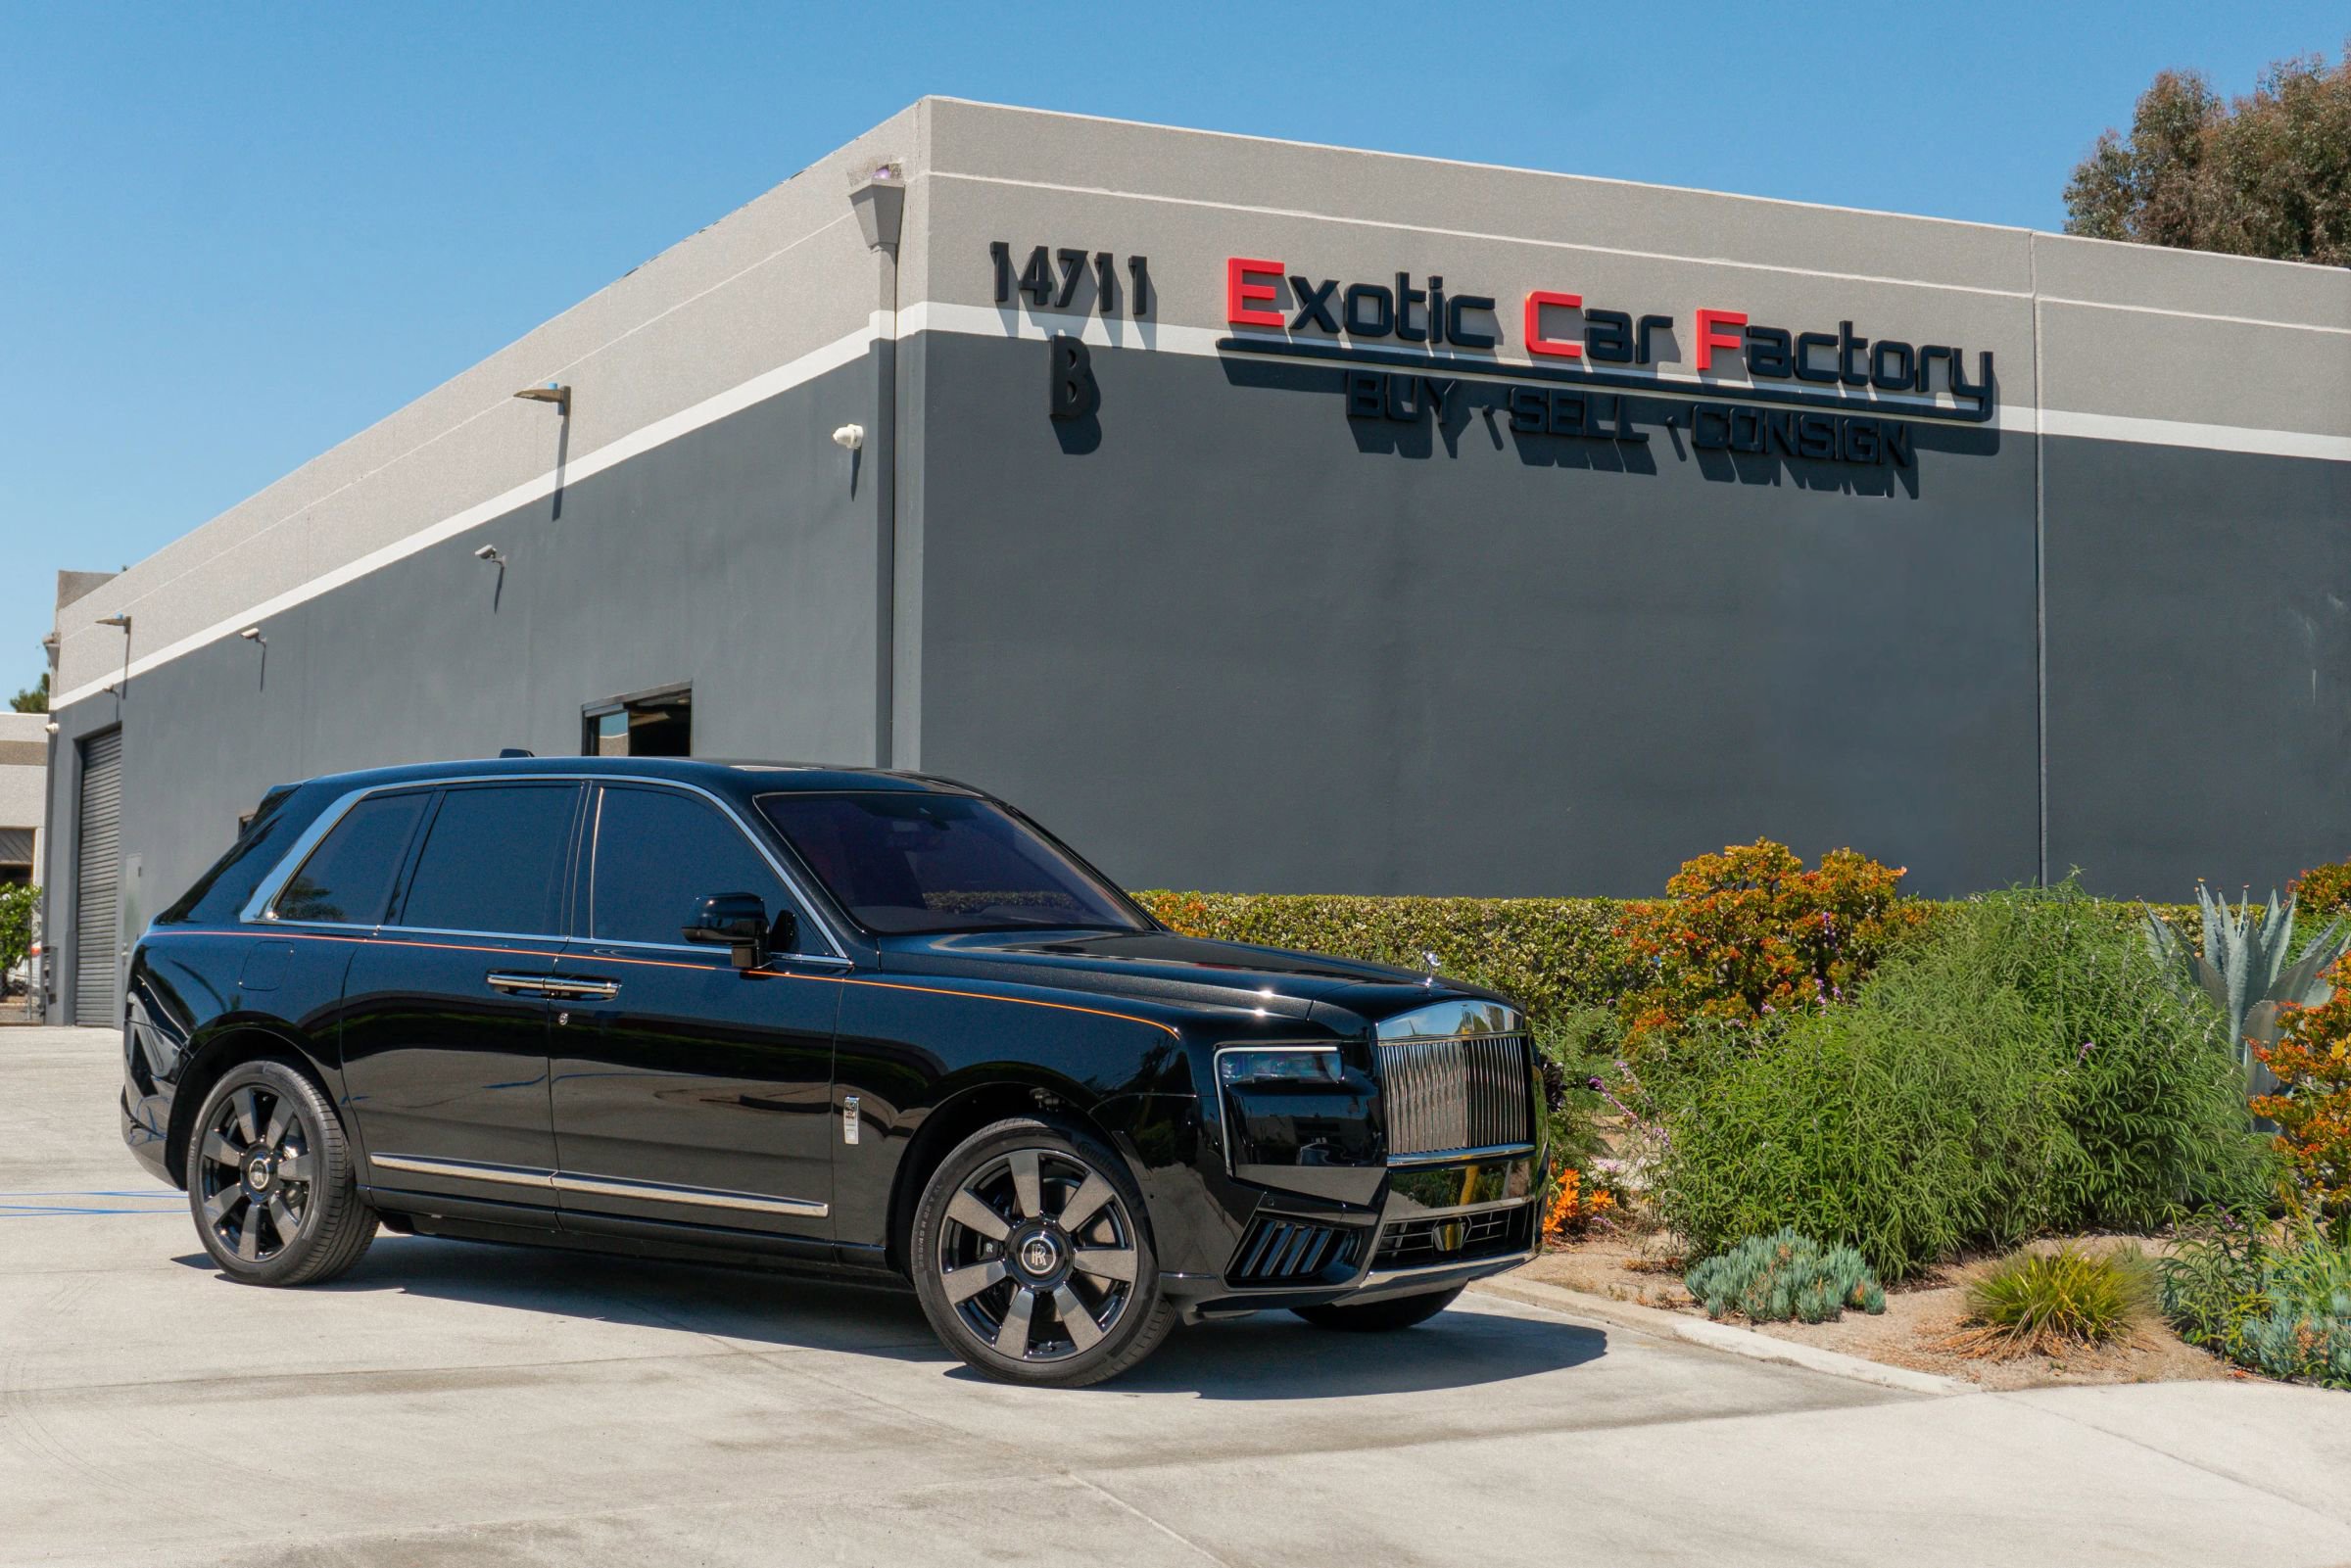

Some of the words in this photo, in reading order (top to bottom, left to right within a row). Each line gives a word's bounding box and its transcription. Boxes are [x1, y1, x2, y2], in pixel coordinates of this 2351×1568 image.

[989, 241, 1147, 315] 14711
[1049, 334, 1091, 418] B
[1227, 257, 1496, 350] Exotic
[1524, 290, 1674, 364] Car
[1696, 308, 1994, 422] Factory
[1346, 369, 1457, 425] BUY
[1509, 386, 1650, 441] SELL
[1691, 404, 1910, 467] CONSIGN
